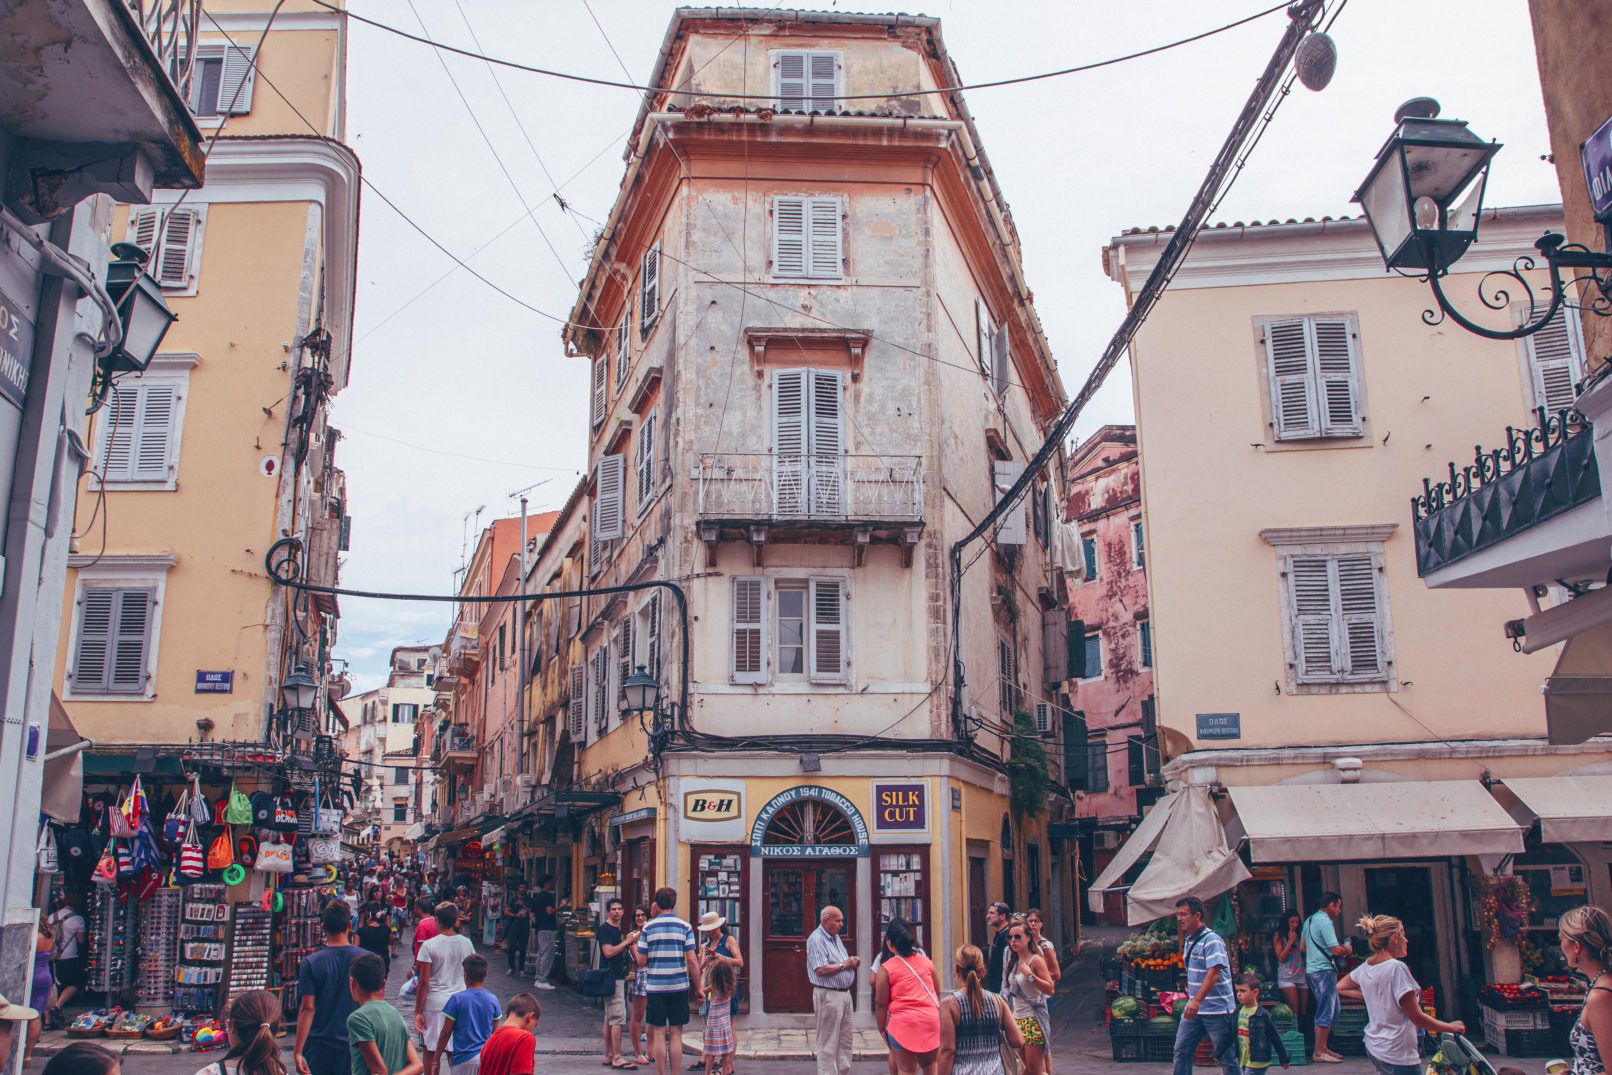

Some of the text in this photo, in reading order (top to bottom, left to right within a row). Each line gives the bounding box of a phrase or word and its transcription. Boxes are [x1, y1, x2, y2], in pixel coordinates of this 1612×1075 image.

[691, 798, 734, 812] B&H
[881, 791, 920, 806] SILK
[752, 787, 869, 847] ΣΠΙΤΙ ΚΑΠΝΟΥ 1941 TOBACCO HOUSE
[884, 807, 917, 822] CUT
[760, 846, 858, 855] ΝΙΚΟΣ ΑΓΑΘΟΣ
